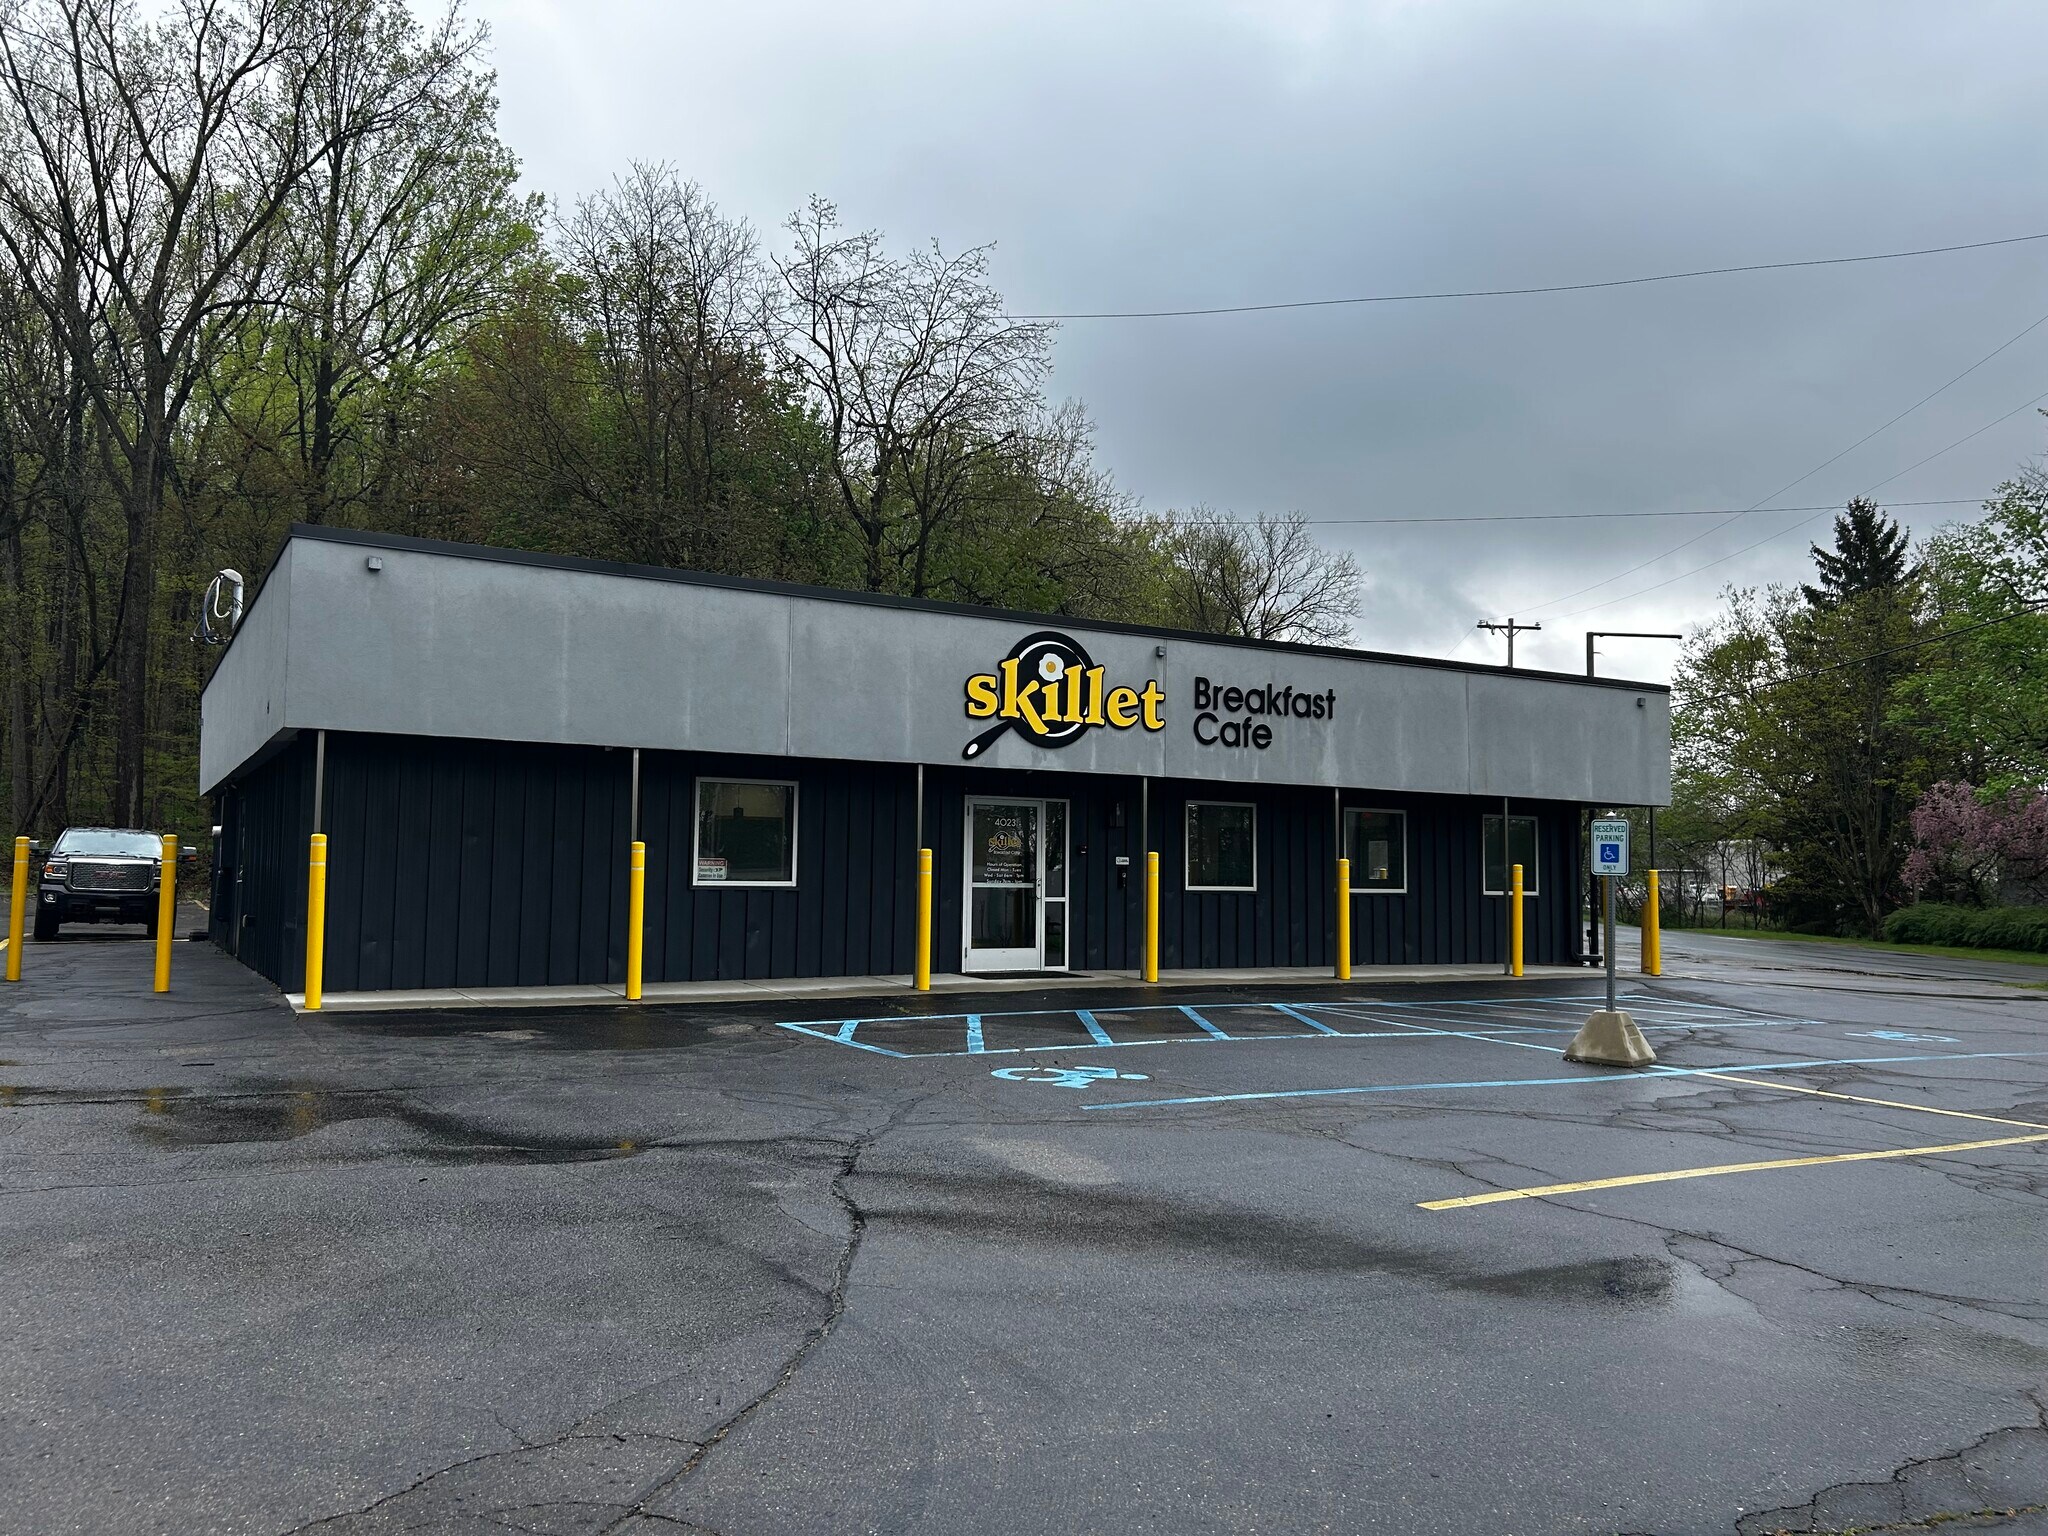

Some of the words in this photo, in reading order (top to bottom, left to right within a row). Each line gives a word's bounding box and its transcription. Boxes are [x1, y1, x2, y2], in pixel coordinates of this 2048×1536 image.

[966, 656, 1166, 735] skillet
[1194, 676, 1336, 719] Breakfast
[1193, 712, 1273, 749] Cafe
[994, 818, 1016, 827] 4023
[1594, 825, 1626, 833] RESERVED
[1595, 834, 1625, 842] PARKING
